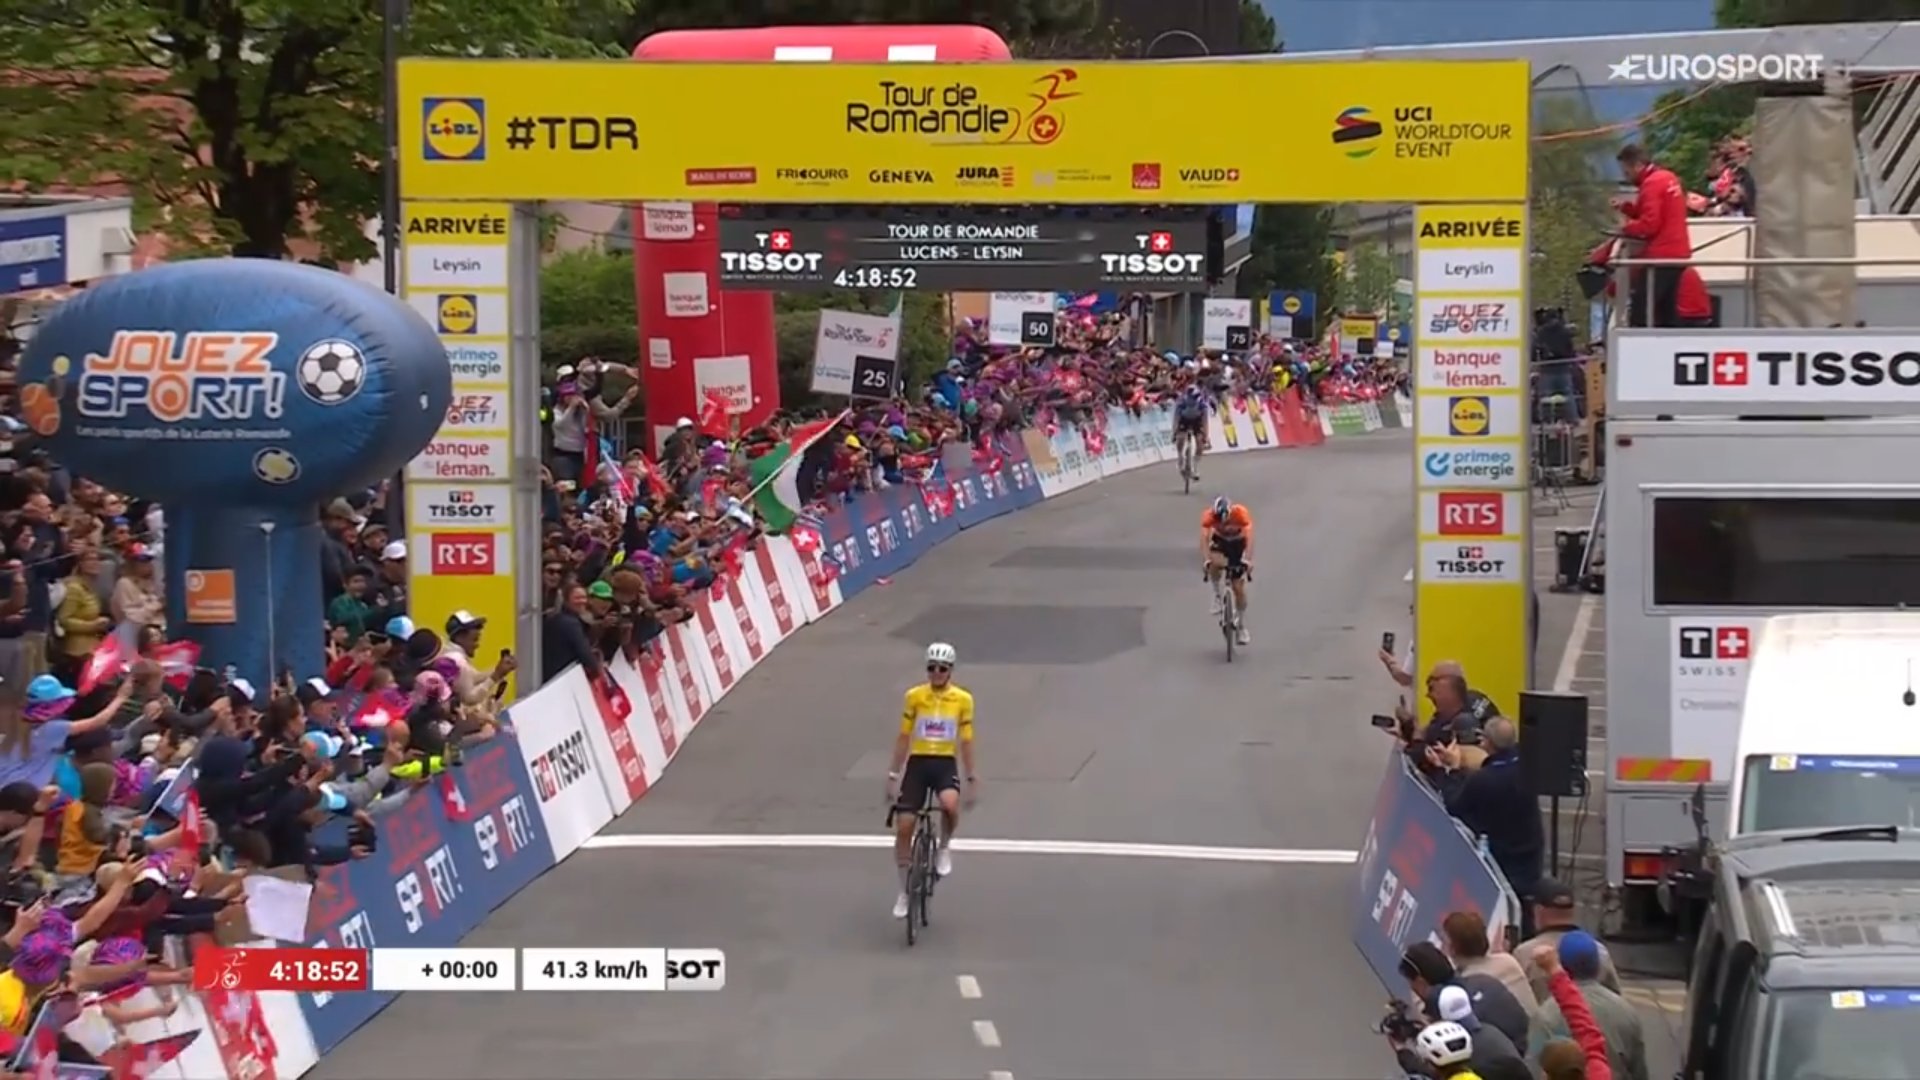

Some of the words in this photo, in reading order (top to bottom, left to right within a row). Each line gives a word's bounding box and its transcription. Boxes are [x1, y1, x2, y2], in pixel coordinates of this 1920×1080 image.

[879, 81, 935, 107] Tour
[943, 82, 977, 107] de
[846, 103, 1009, 134] Romandie
[1394, 106, 1432, 122] UCI
[506, 116, 639, 151] #TDR
[1395, 124, 1511, 140] WORLDTOUR
[1395, 142, 1453, 158] EVENT
[869, 169, 934, 183] GENEVA
[956, 167, 999, 179] JURA
[1179, 168, 1225, 181] VAUD
[407, 214, 506, 234] ARRIVÉE
[888, 225, 930, 238] TOUR
[933, 225, 952, 238] DE
[956, 225, 1039, 238] ROMANDIE
[1420, 217, 1521, 238] ARRIVÉE
[900, 246, 959, 259] LUCENS
[973, 246, 1023, 259] LEYSIN
[433, 258, 481, 274] Leysin
[721, 252, 823, 272] TISSOT
[1101, 254, 1203, 273] TISSOT
[1444, 262, 1494, 278] Leysin
[833, 268, 917, 287] 4:18:52
[1433, 303, 1505, 318] JOUEZ
[1029, 321, 1048, 336] 50
[1231, 333, 1246, 345] 75
[85, 331, 277, 373] JOUEZ
[1434, 350, 1502, 368] banque
[452, 361, 501, 378] nergie
[1757, 351, 1920, 387] TISSO
[862, 369, 886, 387] 25
[80, 372, 286, 421] SPORT!
[451, 396, 492, 409] UEZ
[447, 406, 497, 425] ORT!
[424, 442, 490, 459] banque
[1454, 450, 1511, 465] primeo
[1453, 464, 1514, 480] energie
[428, 505, 495, 517] TISSOT
[1445, 503, 1497, 525] RTS
[438, 543, 489, 565] RTS
[1437, 561, 1505, 573] TISSOT
[1679, 666, 1737, 676] SWISS
[395, 843, 464, 934] SPORT!
